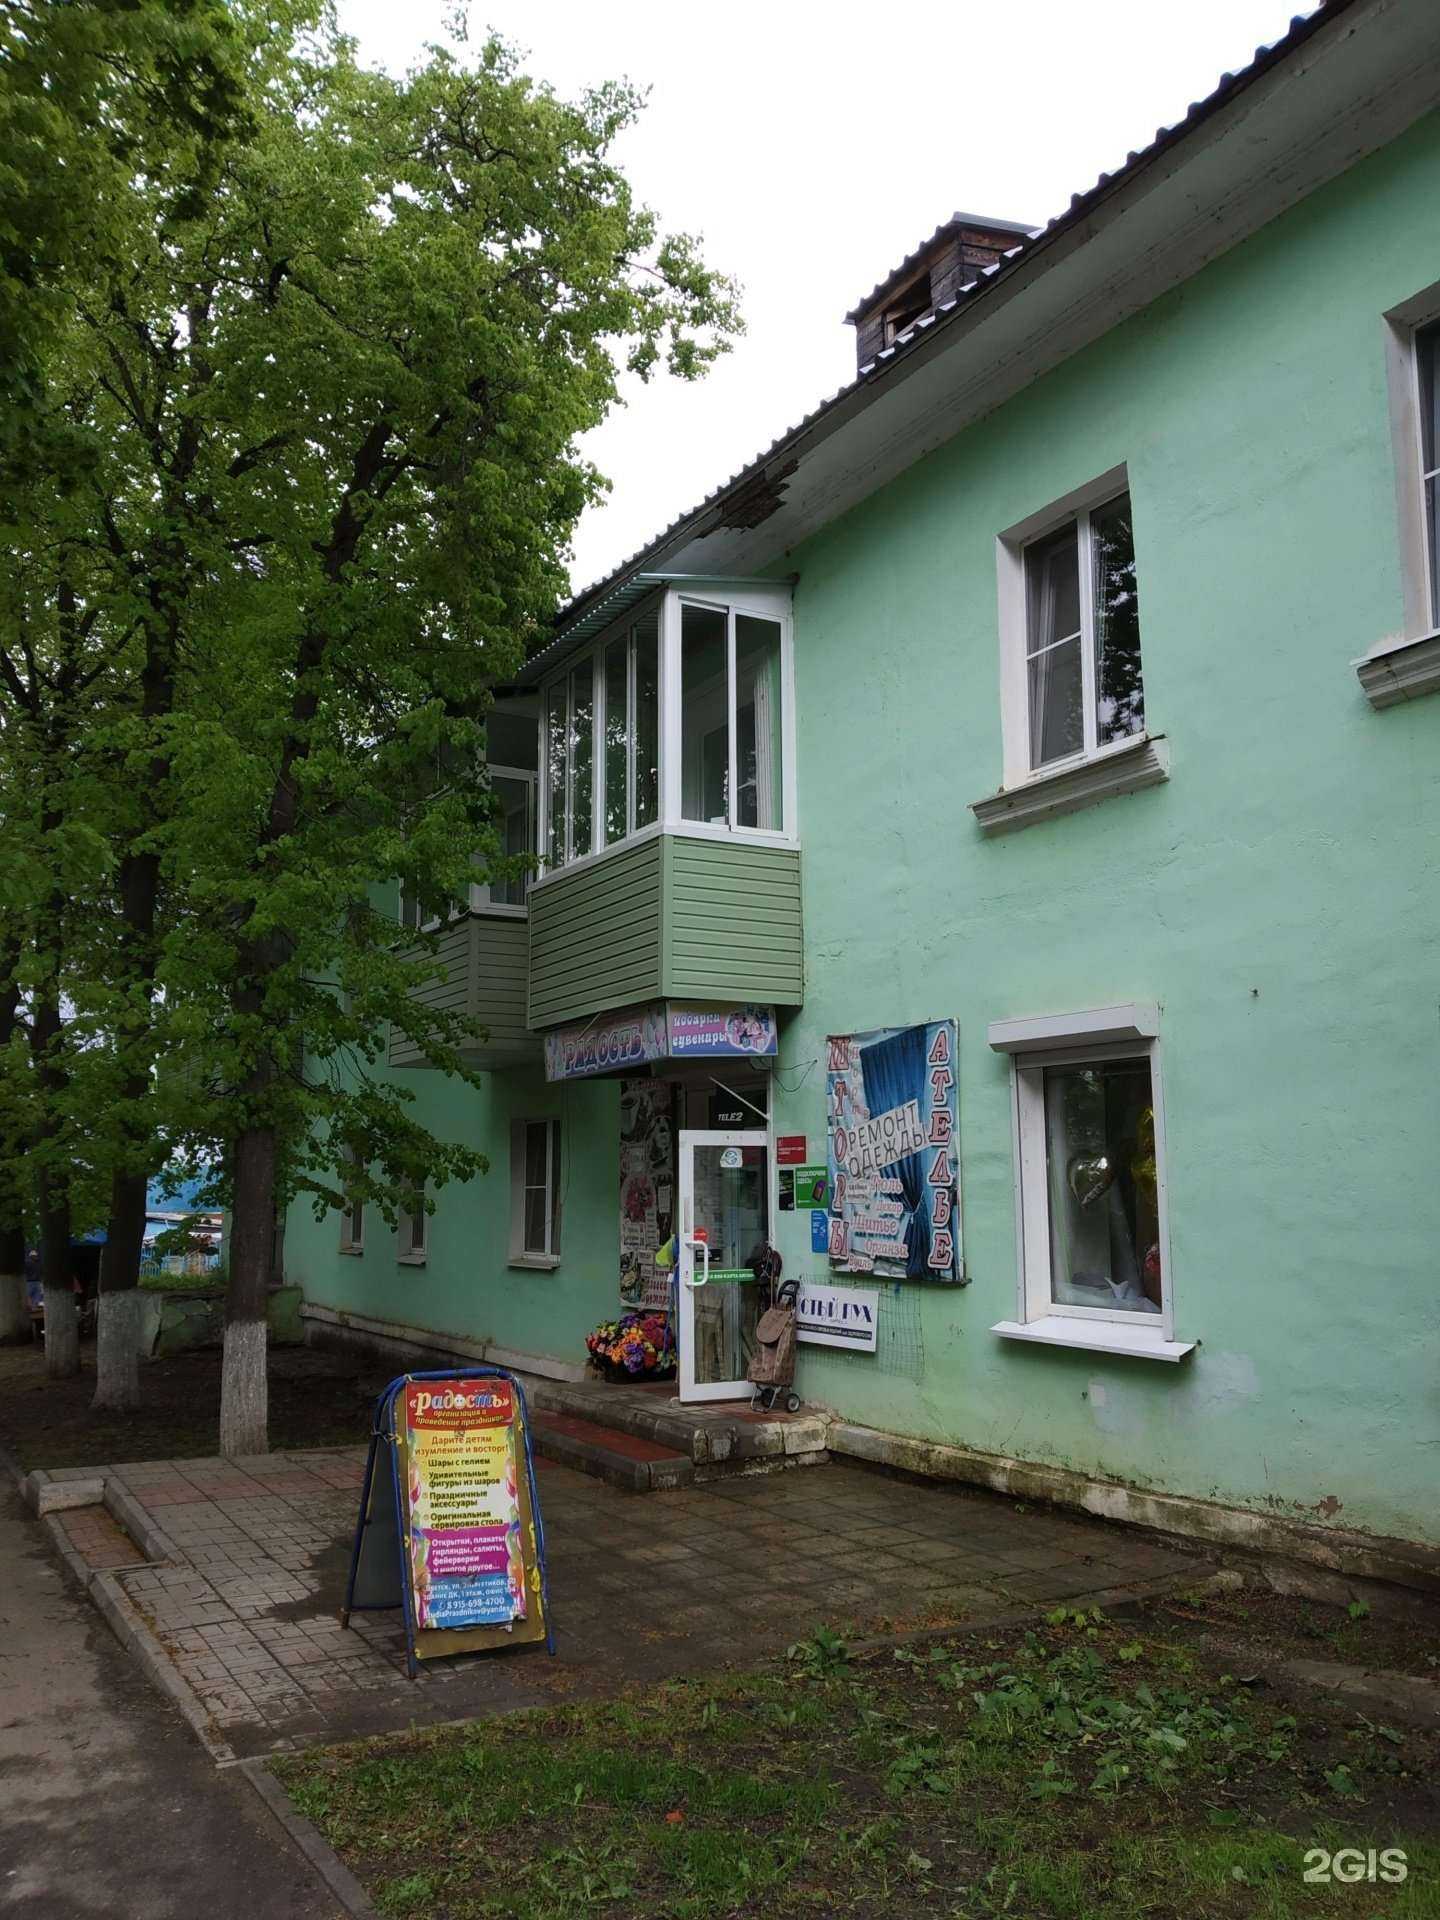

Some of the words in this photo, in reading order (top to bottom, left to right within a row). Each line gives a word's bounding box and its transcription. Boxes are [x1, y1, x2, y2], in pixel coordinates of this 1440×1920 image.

[564, 1024, 643, 1073] РАДОСТЬ
[718, 1111, 744, 1121] TELE2
[848, 1102, 916, 1152] РЕМОНТ
[827, 1037, 850, 1258] ШТОРЫ
[848, 1125, 927, 1178] ОДЕЖДЫ
[928, 1029, 951, 1266] АТЕЛЬЕ
[432, 1436, 464, 1445] Дарите
[465, 1435, 492, 1444] детям
[415, 1447, 465, 1457] изумление
[428, 1459, 454, 1468] Шары
[461, 1457, 491, 1465] гелием
[429, 1470, 489, 1480] Удивительные
[429, 1481, 462, 1490] фигуры
[474, 1478, 501, 1487] шаров
[430, 1491, 487, 1501] Праздничные
[430, 1500, 478, 1509] аксессуары
[431, 1510, 491, 1522] Оригинальная
[431, 1520, 480, 1530] сервировка
[480, 1518, 503, 1526] стола
[432, 1538, 473, 1548] Открытки,
[473, 1544, 505, 1553] салюты,
[433, 1555, 480, 1566] фейерверки
